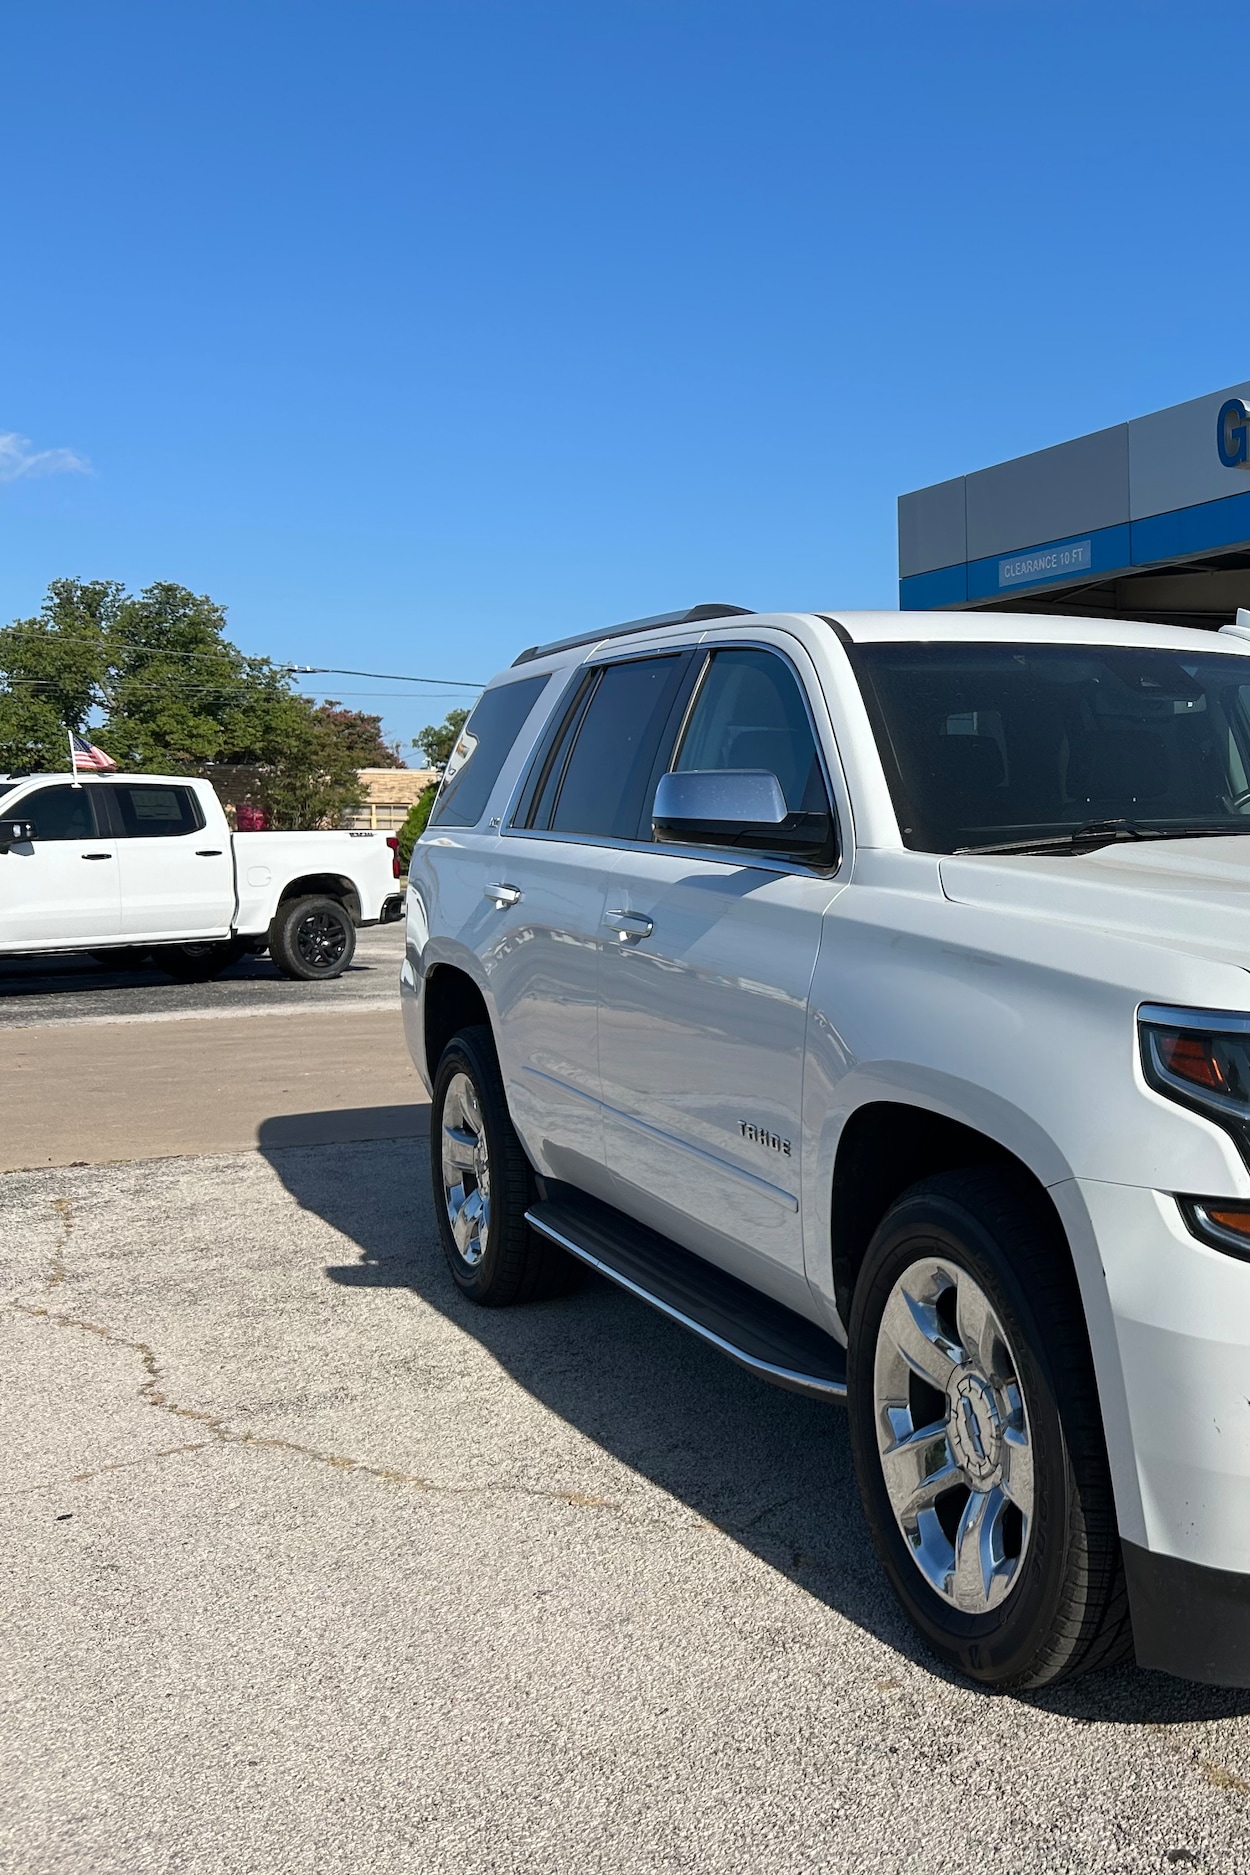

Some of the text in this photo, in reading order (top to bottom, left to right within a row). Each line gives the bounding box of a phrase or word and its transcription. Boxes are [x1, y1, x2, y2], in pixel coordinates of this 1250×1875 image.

[1004, 548, 1083, 578] CLEARANCE 10 FT
[737, 1119, 791, 1157] TAHOE
